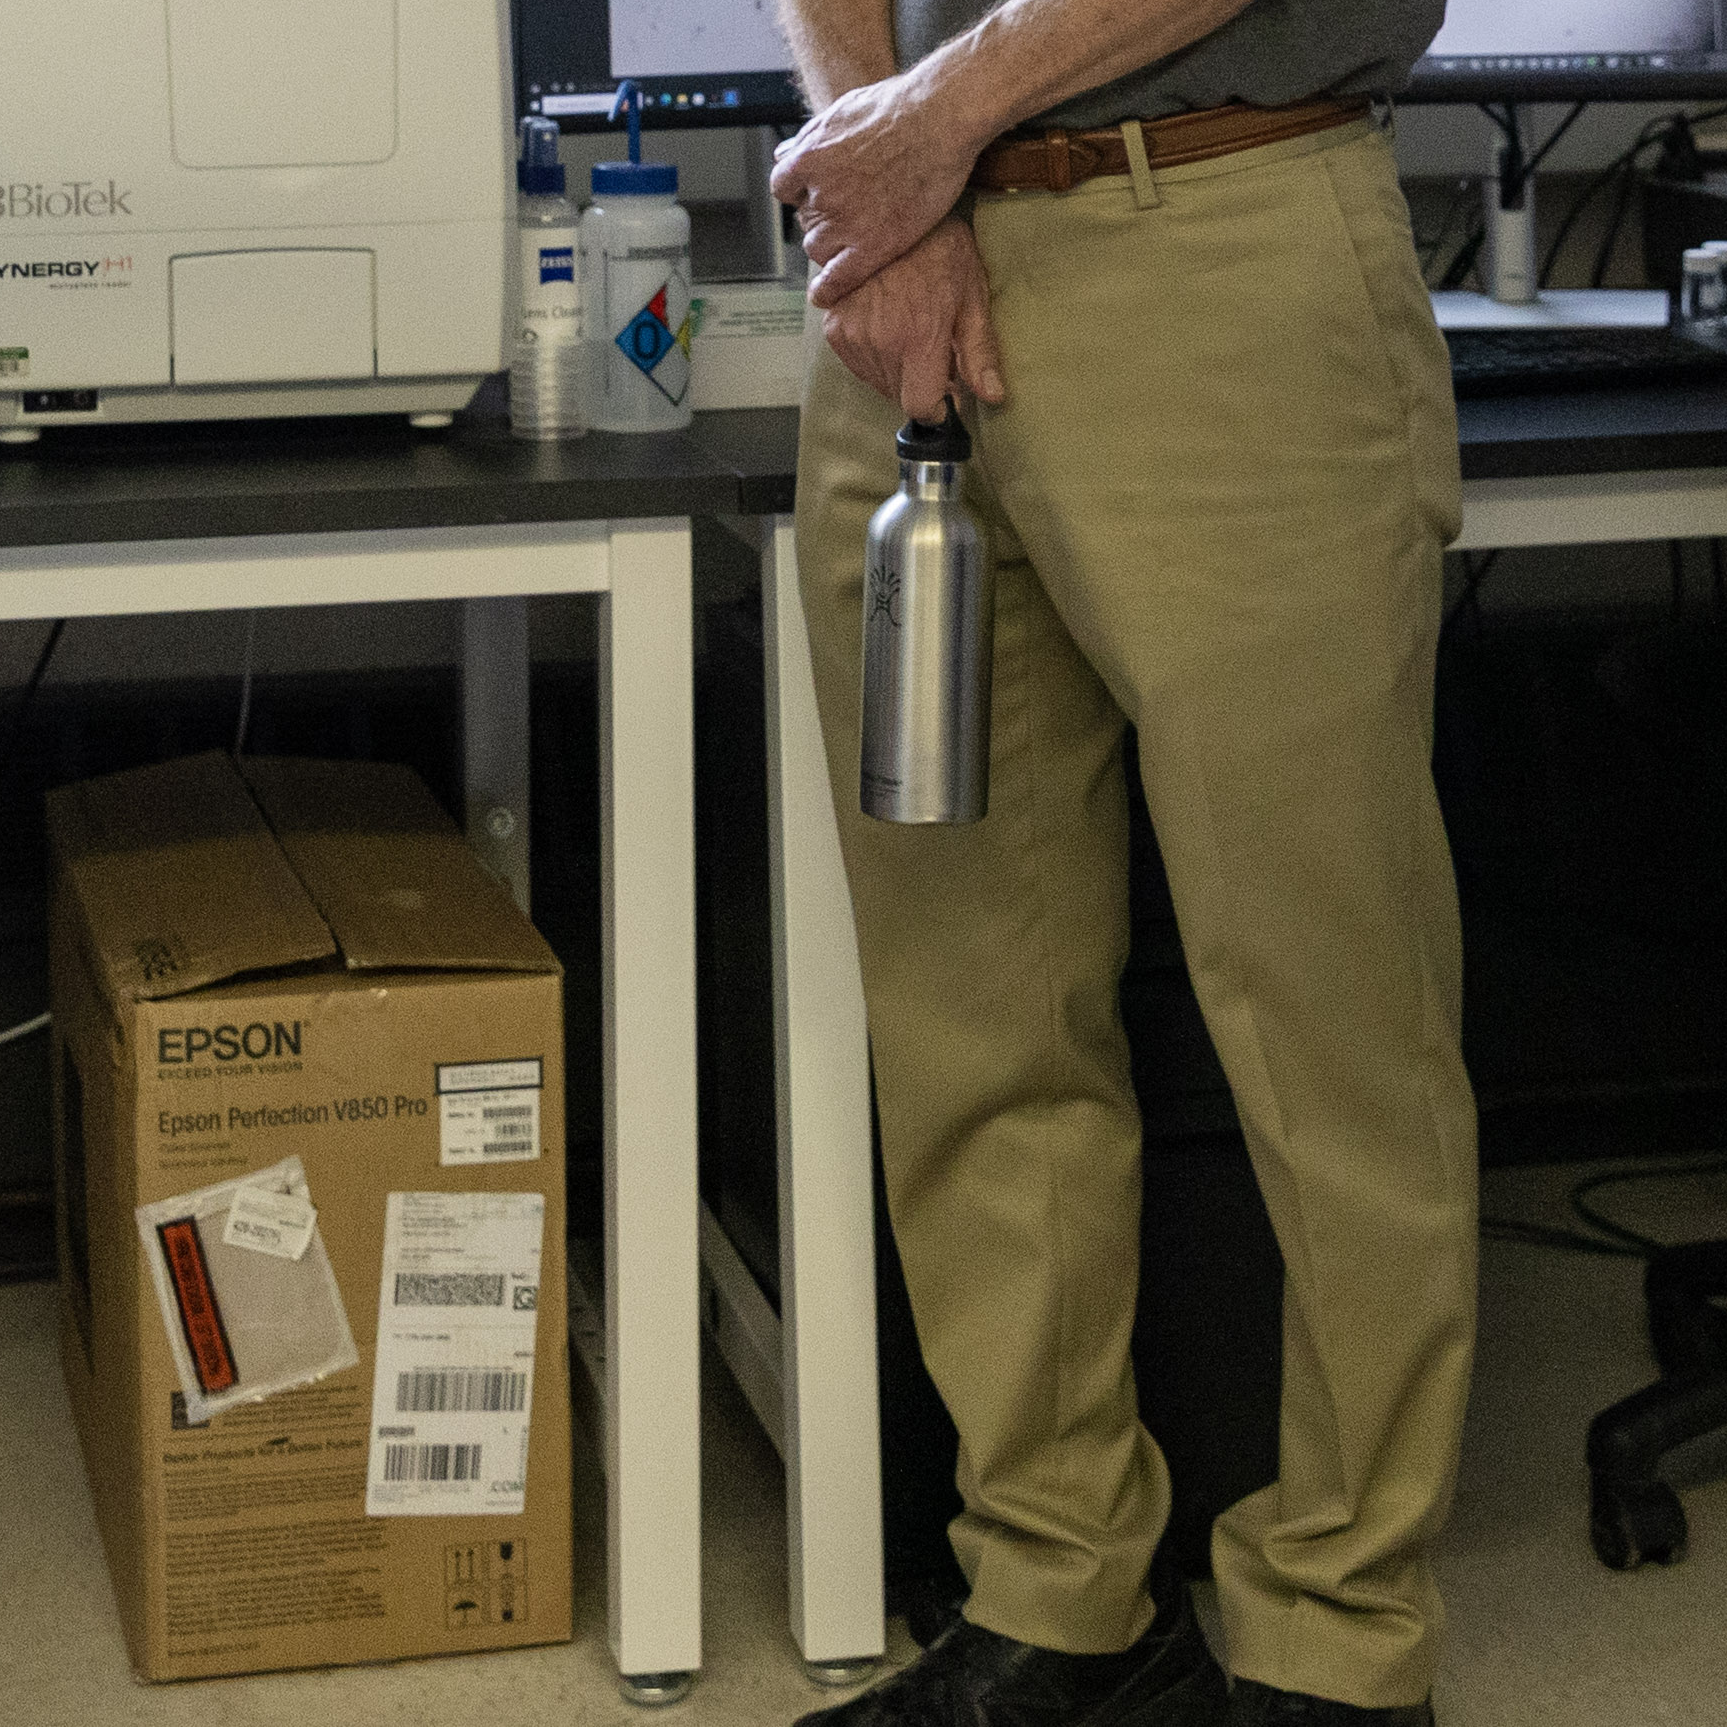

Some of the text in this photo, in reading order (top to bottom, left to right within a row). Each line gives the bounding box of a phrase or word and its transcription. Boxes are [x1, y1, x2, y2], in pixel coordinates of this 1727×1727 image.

[9, 179, 133, 218] BioTek
[635, 321, 661, 360] 0
[158, 1020, 302, 1064] EPSON
[157, 1094, 428, 1137] Epson Perfection V850 Pro
